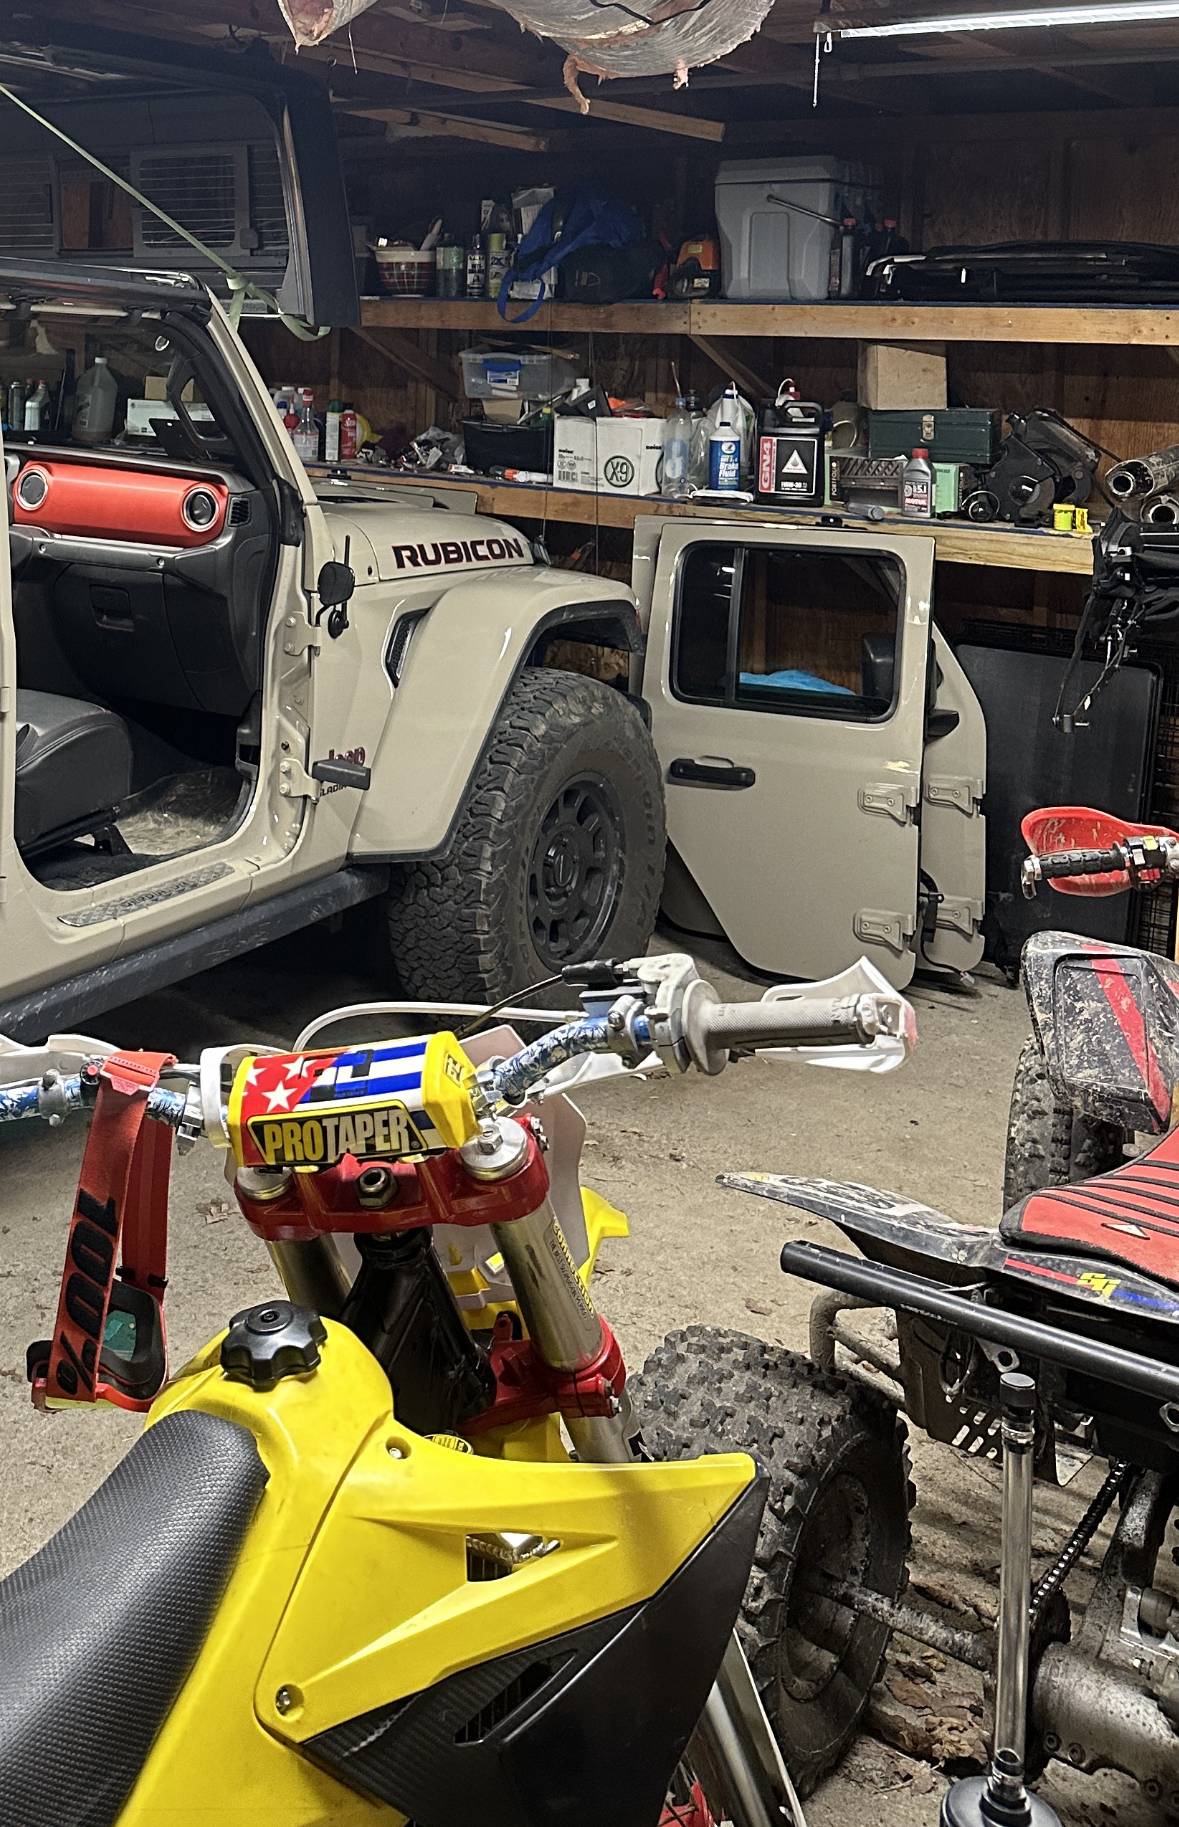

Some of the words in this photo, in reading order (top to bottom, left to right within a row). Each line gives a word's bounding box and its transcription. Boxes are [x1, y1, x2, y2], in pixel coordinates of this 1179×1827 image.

[719, 469, 736, 478] Fluid
[762, 440, 771, 489] GN4
[391, 538, 525, 569] RUBICON
[56, 1188, 119, 1396] 100%
